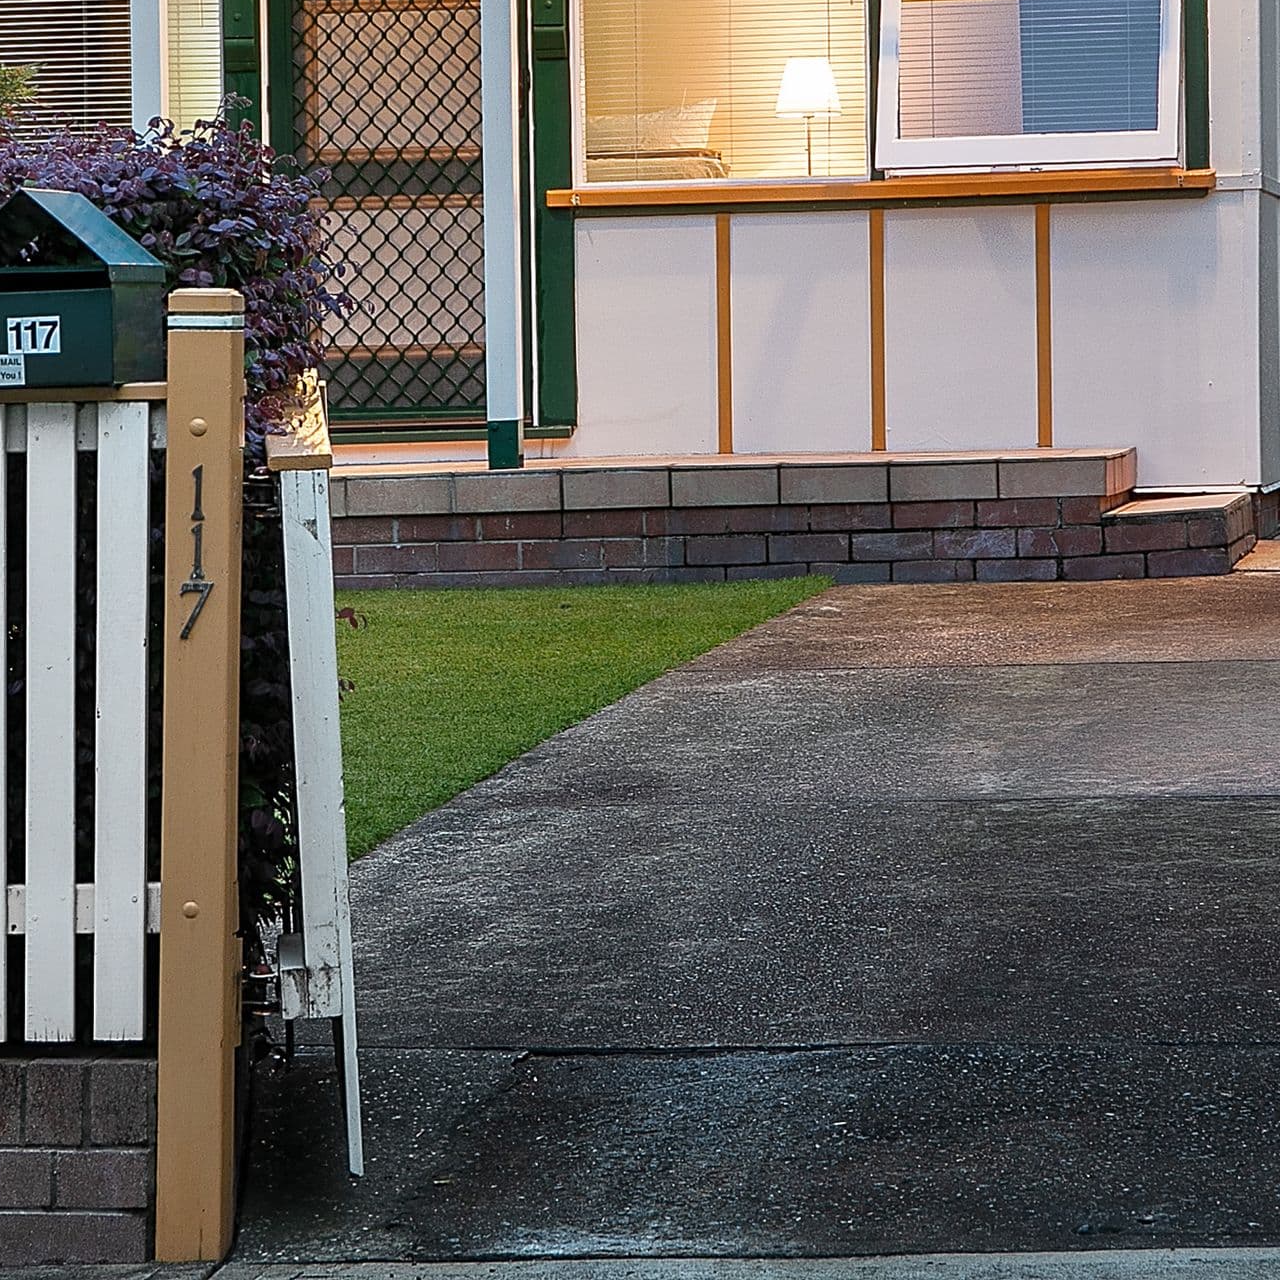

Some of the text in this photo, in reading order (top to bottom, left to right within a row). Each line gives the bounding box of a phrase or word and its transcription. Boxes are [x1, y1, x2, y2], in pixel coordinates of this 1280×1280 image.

[9, 321, 58, 350] 117
[0, 358, 22, 366] MAIL
[179, 464, 214, 640] 117
